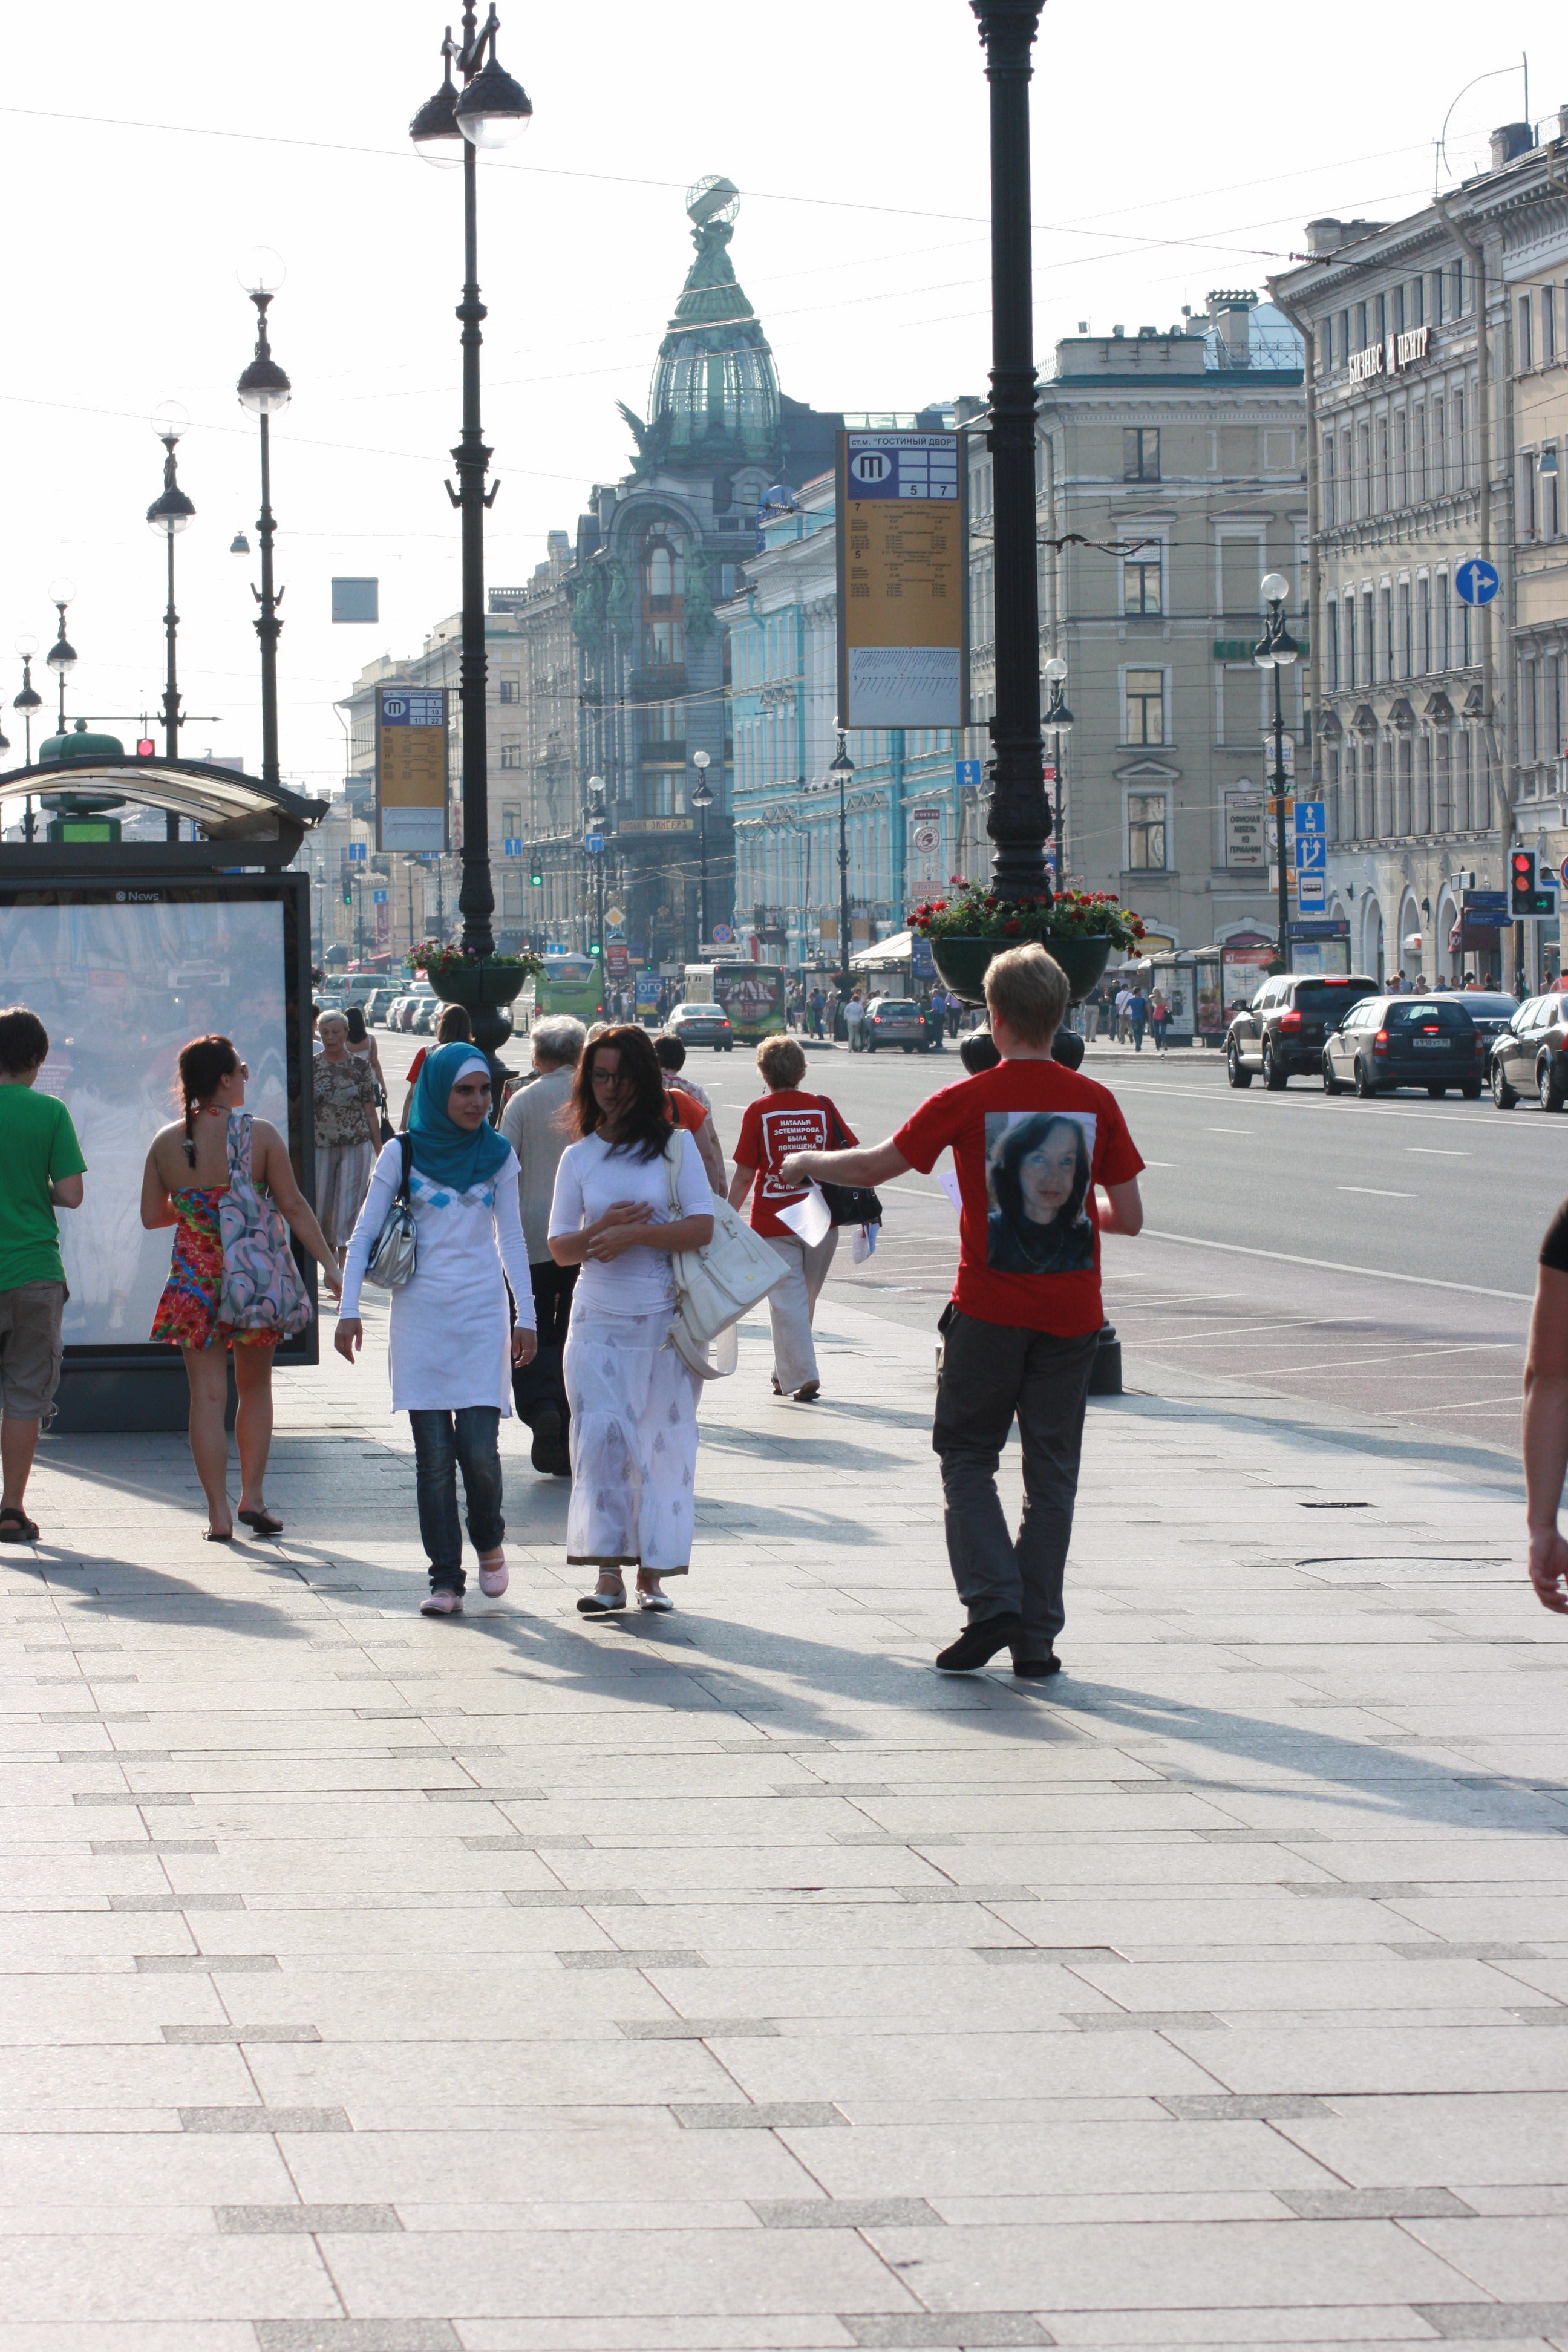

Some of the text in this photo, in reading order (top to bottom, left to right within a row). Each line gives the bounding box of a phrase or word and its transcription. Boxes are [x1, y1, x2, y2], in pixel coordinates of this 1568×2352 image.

[1348, 326, 1428, 385] БИЗНЕС ЦЕНТР
[910, 485, 947, 496] 5 7
[855, 503, 861, 511] 7
[855, 550, 861, 559] 5
[651, 820, 688, 829] ЗИНГЕРЪ
[774, 1127, 820, 1135] ЭСТЕМИРОВА
